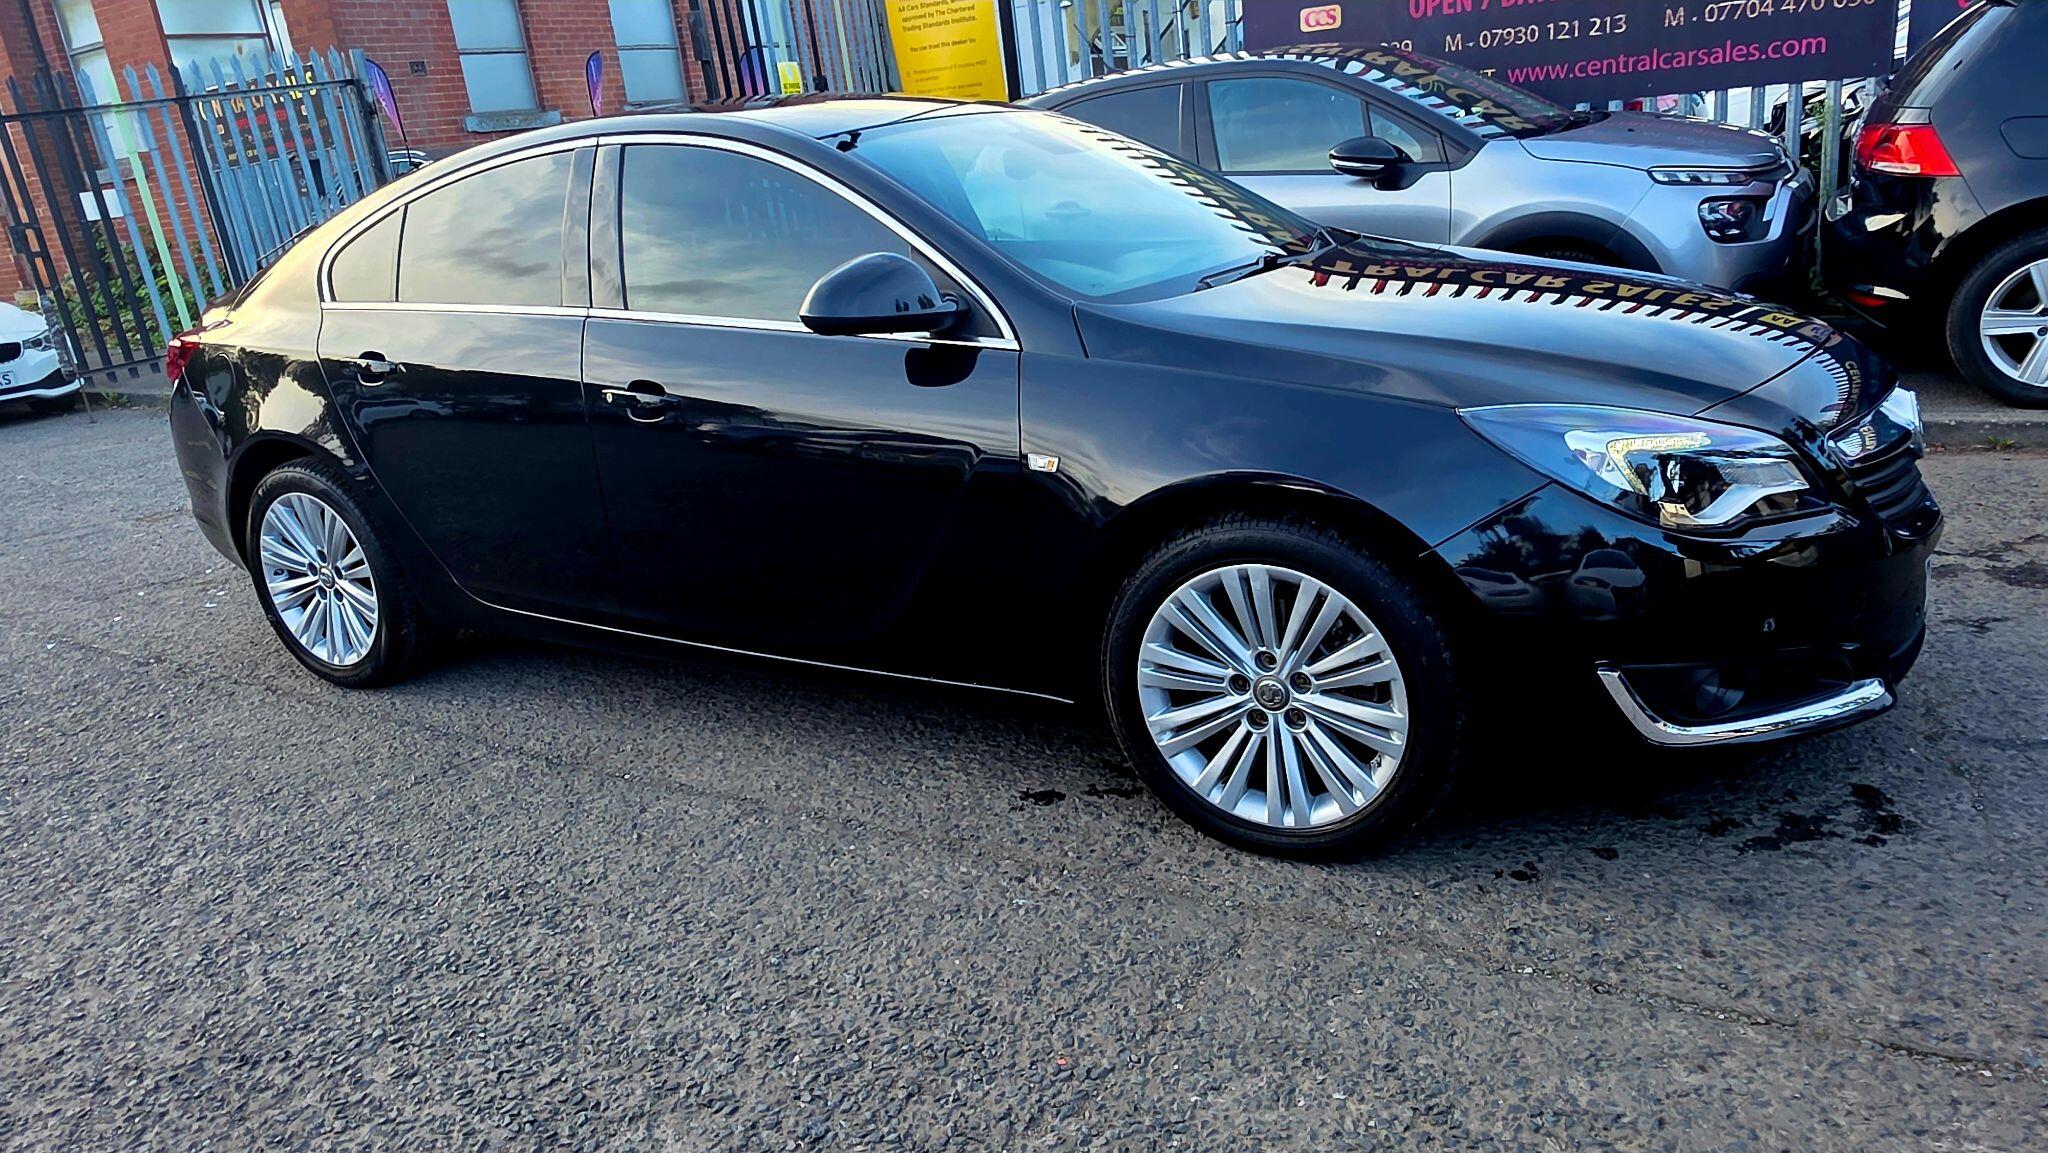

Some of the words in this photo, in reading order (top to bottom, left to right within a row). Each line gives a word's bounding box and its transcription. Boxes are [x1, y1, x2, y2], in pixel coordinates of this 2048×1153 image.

[902, 12, 926, 22] approved
[935, 8, 946, 16] The
[946, 4, 975, 14] Chartered
[1704, 0, 1774, 23] 07704
[902, 23, 922, 33] Trading
[922, 19, 950, 29] Standards
[1479, 25, 1539, 49] 07930
[1547, 19, 1579, 40] 121
[1589, 14, 1627, 37] 213
[1507, 34, 1827, 84] www.centralcarsales.com
